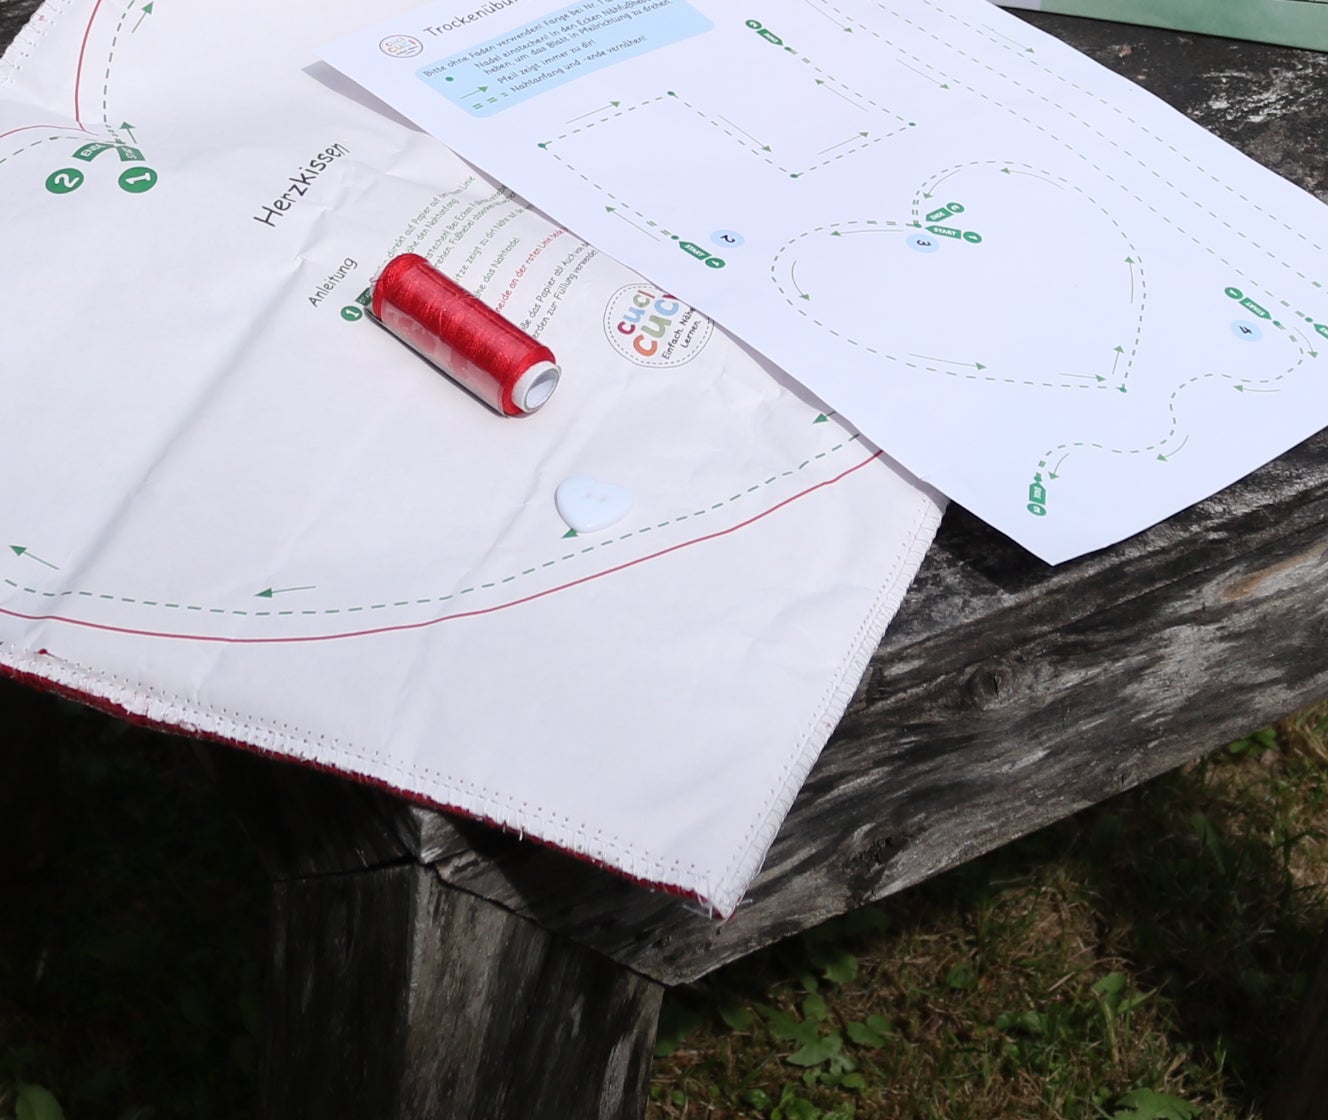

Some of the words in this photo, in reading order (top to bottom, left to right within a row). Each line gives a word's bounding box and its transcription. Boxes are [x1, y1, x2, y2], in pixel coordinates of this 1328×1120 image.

[423, 65, 447, 78] Bitte
[447, 56, 470, 68] ohne
[468, 46, 496, 58] Faden
[496, 23, 544, 47] verwenden!
[543, 13, 568, 26] Fange
[568, 6, 584, 16] bei
[474, 55, 501, 69] Nadel
[502, 34, 550, 58] einstechen!
[560, 22, 578, 32] den
[576, 12, 603, 26] Ecken
[530, 46, 547, 56] das
[546, 36, 570, 49] Blatt
[578, 12, 633, 35] Pfeilrichtung
[496, 71, 520, 84] Pfeil
[519, 63, 541, 76] zeigt
[540, 50, 569, 65] immer
[569, 46, 581, 54] zu
[510, 68, 565, 93] Nahtanfang
[564, 59, 582, 70] und
[607, 34, 648, 52] vernähen!
[54, 173, 80, 188] 2
[125, 172, 151, 185] 1
[253, 142, 351, 228] Herzkissen
[308, 256, 358, 308] Anleitung
[484, 269, 496, 283] das
[509, 278, 520, 290] an
[516, 264, 528, 279] der
[526, 248, 542, 266] roten
[345, 308, 360, 318] 1
[530, 304, 542, 318] das
[536, 276, 556, 303] Papier
[546, 302, 558, 316] zur
[553, 272, 578, 301] Füllung
[661, 328, 684, 360] Einfach.
[680, 320, 702, 349] Lernen.
[1239, 325, 1254, 335] 4
